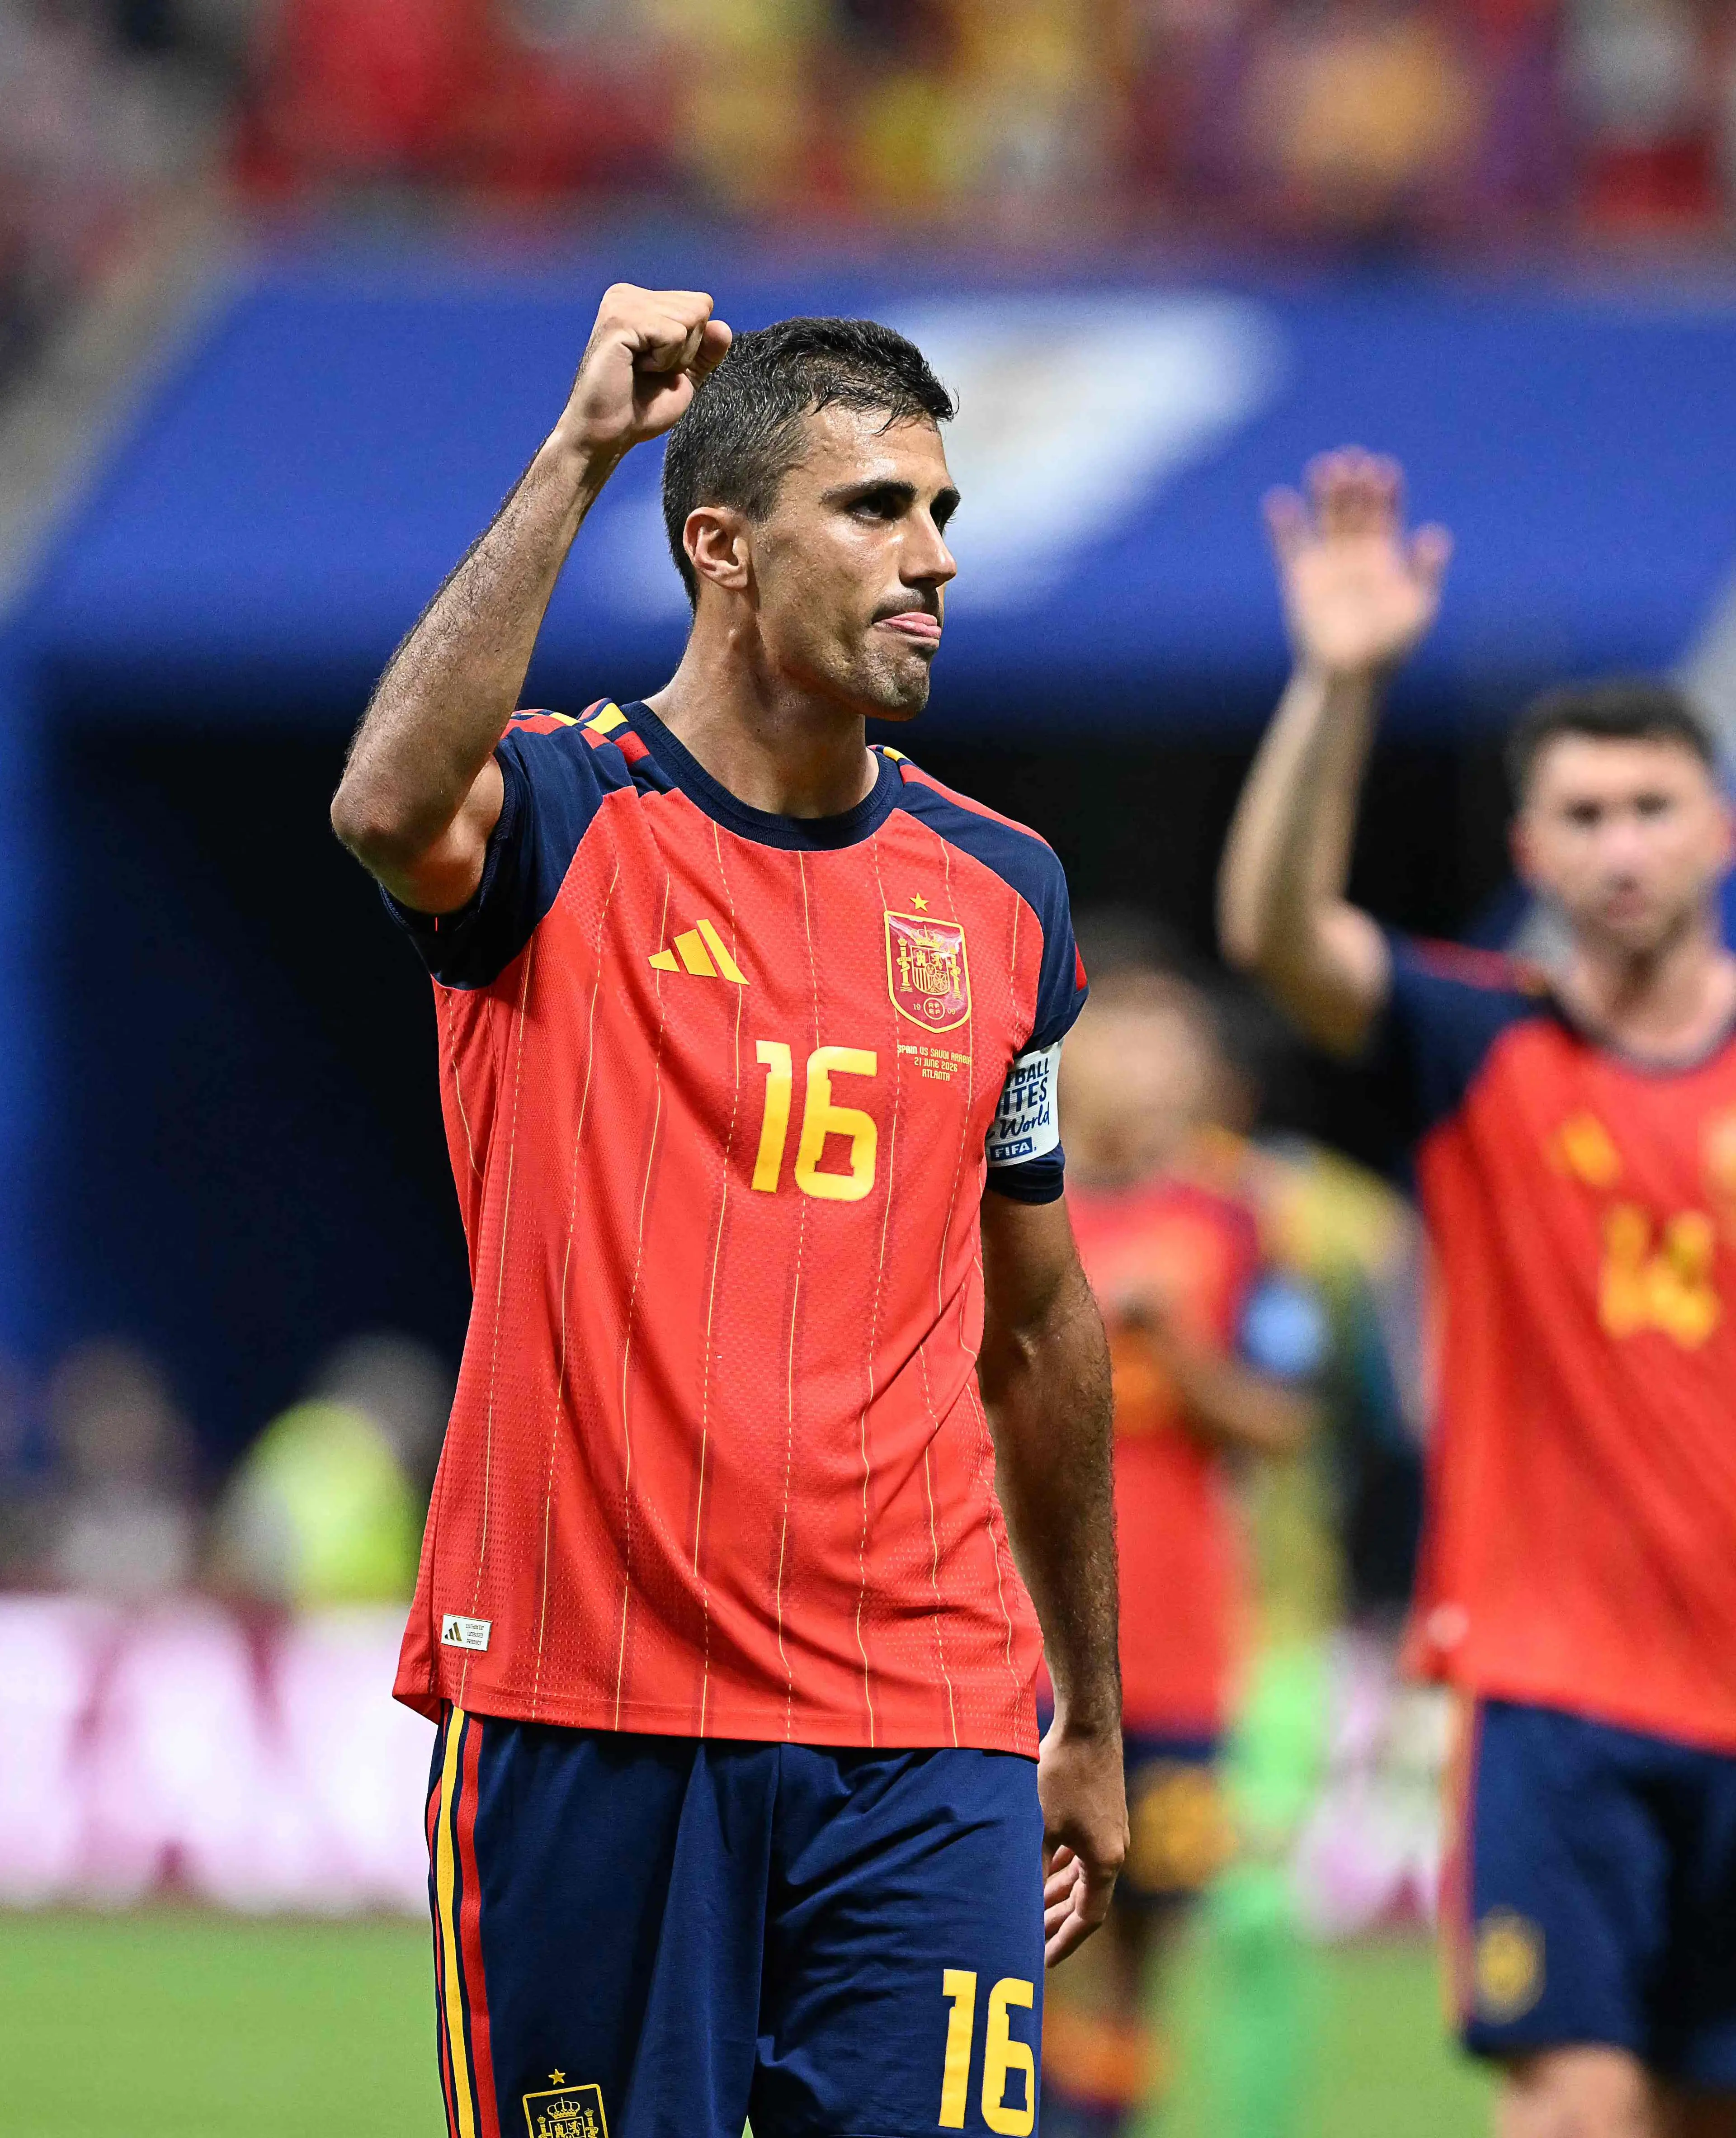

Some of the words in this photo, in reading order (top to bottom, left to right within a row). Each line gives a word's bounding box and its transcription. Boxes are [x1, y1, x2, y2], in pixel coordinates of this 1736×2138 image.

[897, 1044, 918, 1054] SPAIN
[930, 1048, 949, 1060] SAUDI
[951, 1052, 972, 1066] ARABIA
[914, 1057, 921, 1066] 21
[924, 1058, 939, 1068] JUNE
[941, 1061, 958, 1072] 2026
[922, 1069, 950, 1081] ATLANTA
[750, 1040, 878, 1202] 16
[1000, 1101, 1049, 1139] World
[995, 1142, 1030, 1157] FIFA
[938, 1968, 1035, 2138] 16
